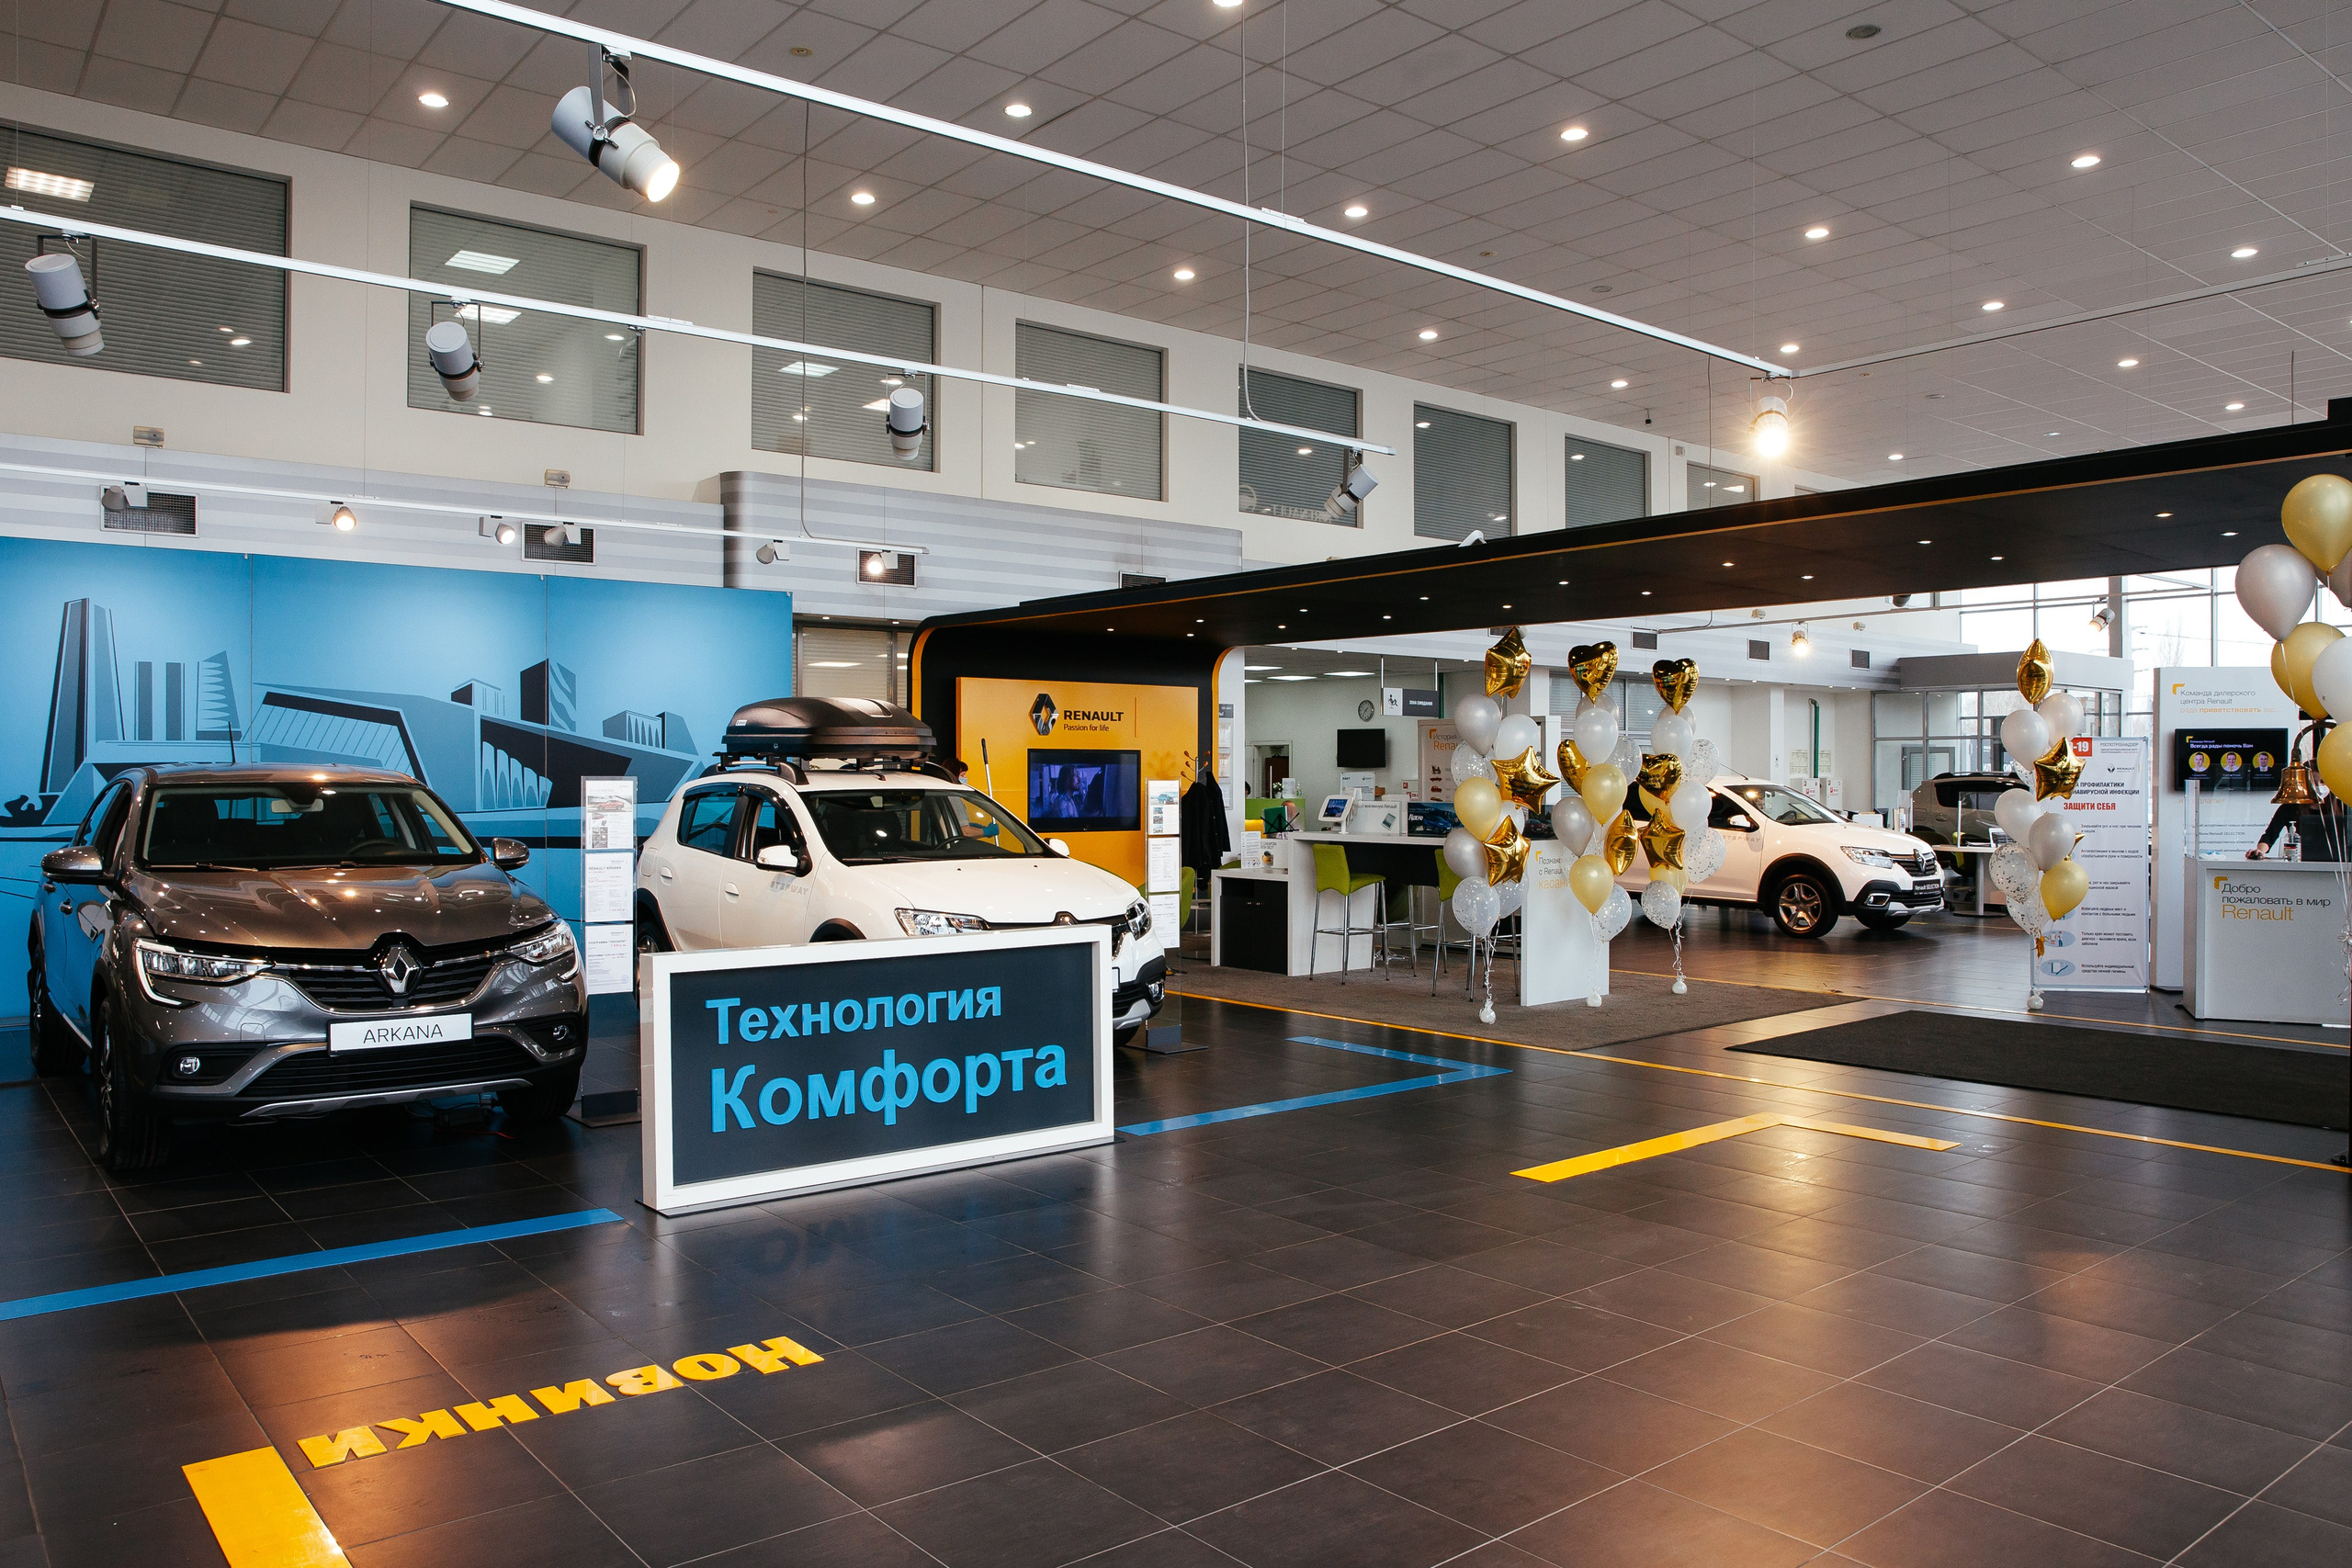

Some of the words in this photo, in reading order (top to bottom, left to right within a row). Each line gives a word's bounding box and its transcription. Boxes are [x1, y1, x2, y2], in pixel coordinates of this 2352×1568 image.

[1063, 710, 1124, 721] RENAULT
[1433, 741, 1458, 750] Rena
[2064, 803, 2095, 811] ЗАЩИТИ
[2222, 883, 2260, 894] Добро
[2222, 896, 2293, 905] пожаловать
[2307, 899, 2331, 908] мир
[2222, 904, 2293, 921] Renault
[706, 987, 1001, 1044] Технология
[363, 1024, 443, 1043] ARKANA
[712, 1045, 1067, 1133] Комфорта
[297, 1337, 824, 1468] НОВИНКИ
